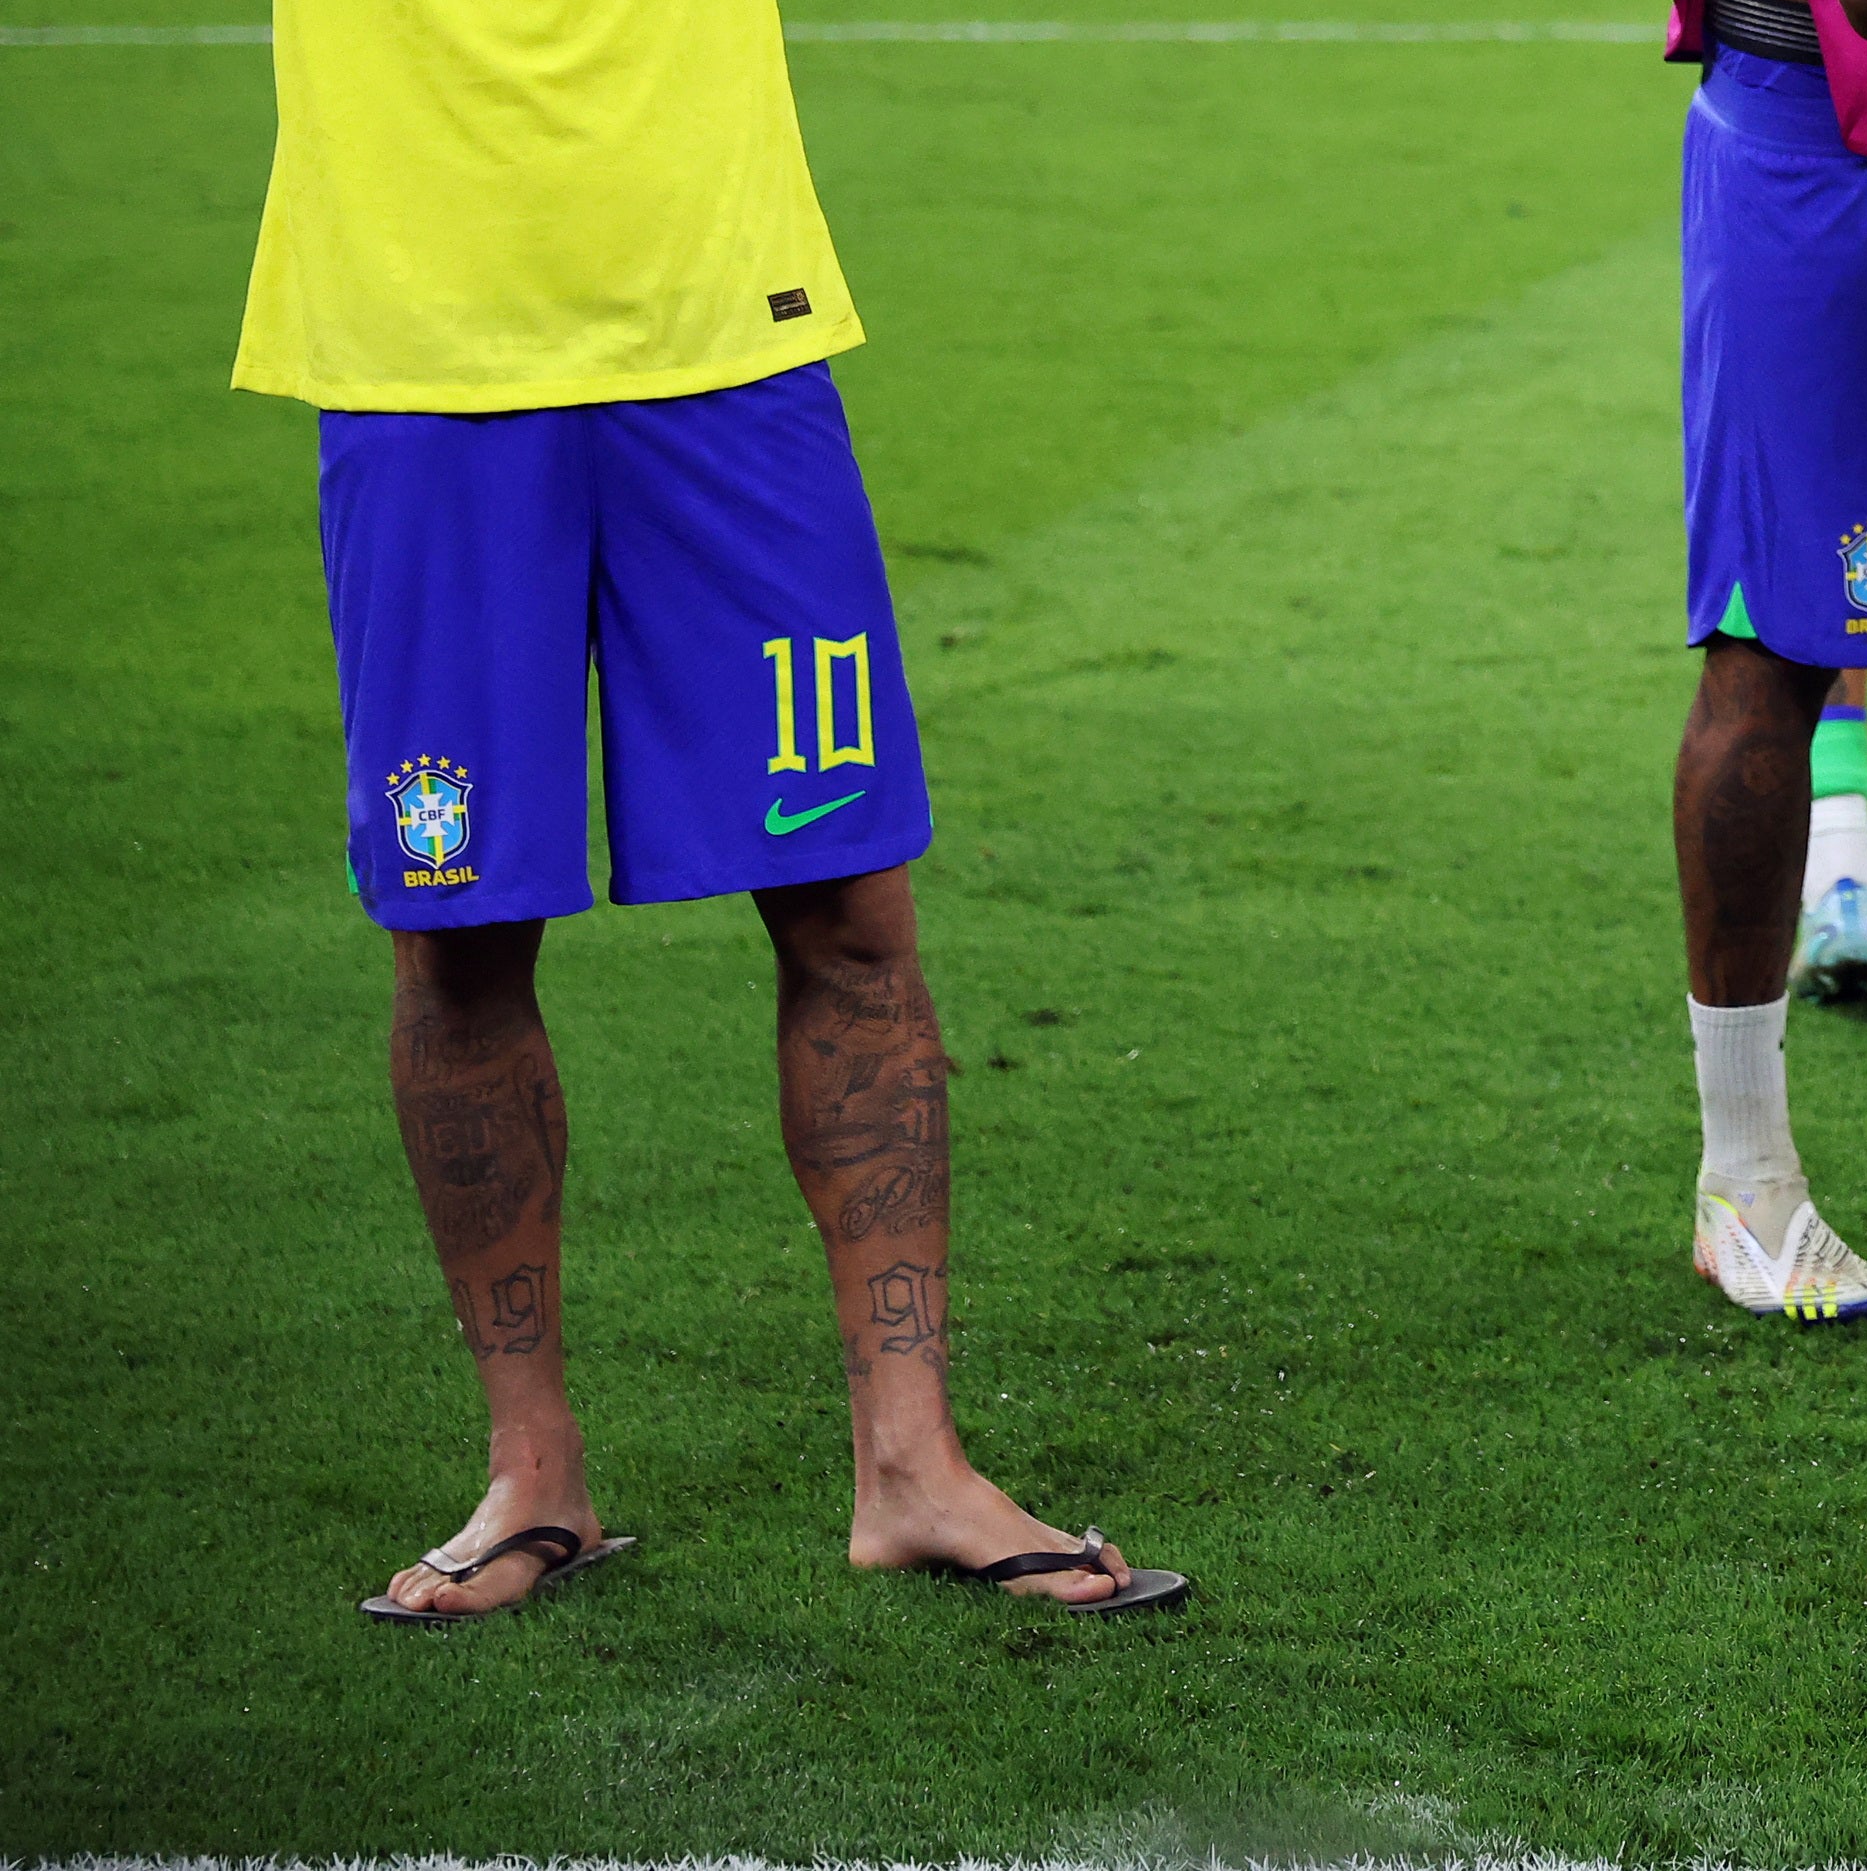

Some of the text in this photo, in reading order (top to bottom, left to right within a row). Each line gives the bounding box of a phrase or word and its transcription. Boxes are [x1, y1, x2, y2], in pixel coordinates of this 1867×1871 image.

[761, 630, 877, 775] 10
[418, 808, 447, 822] CBF
[403, 865, 481, 888] BRASIL
